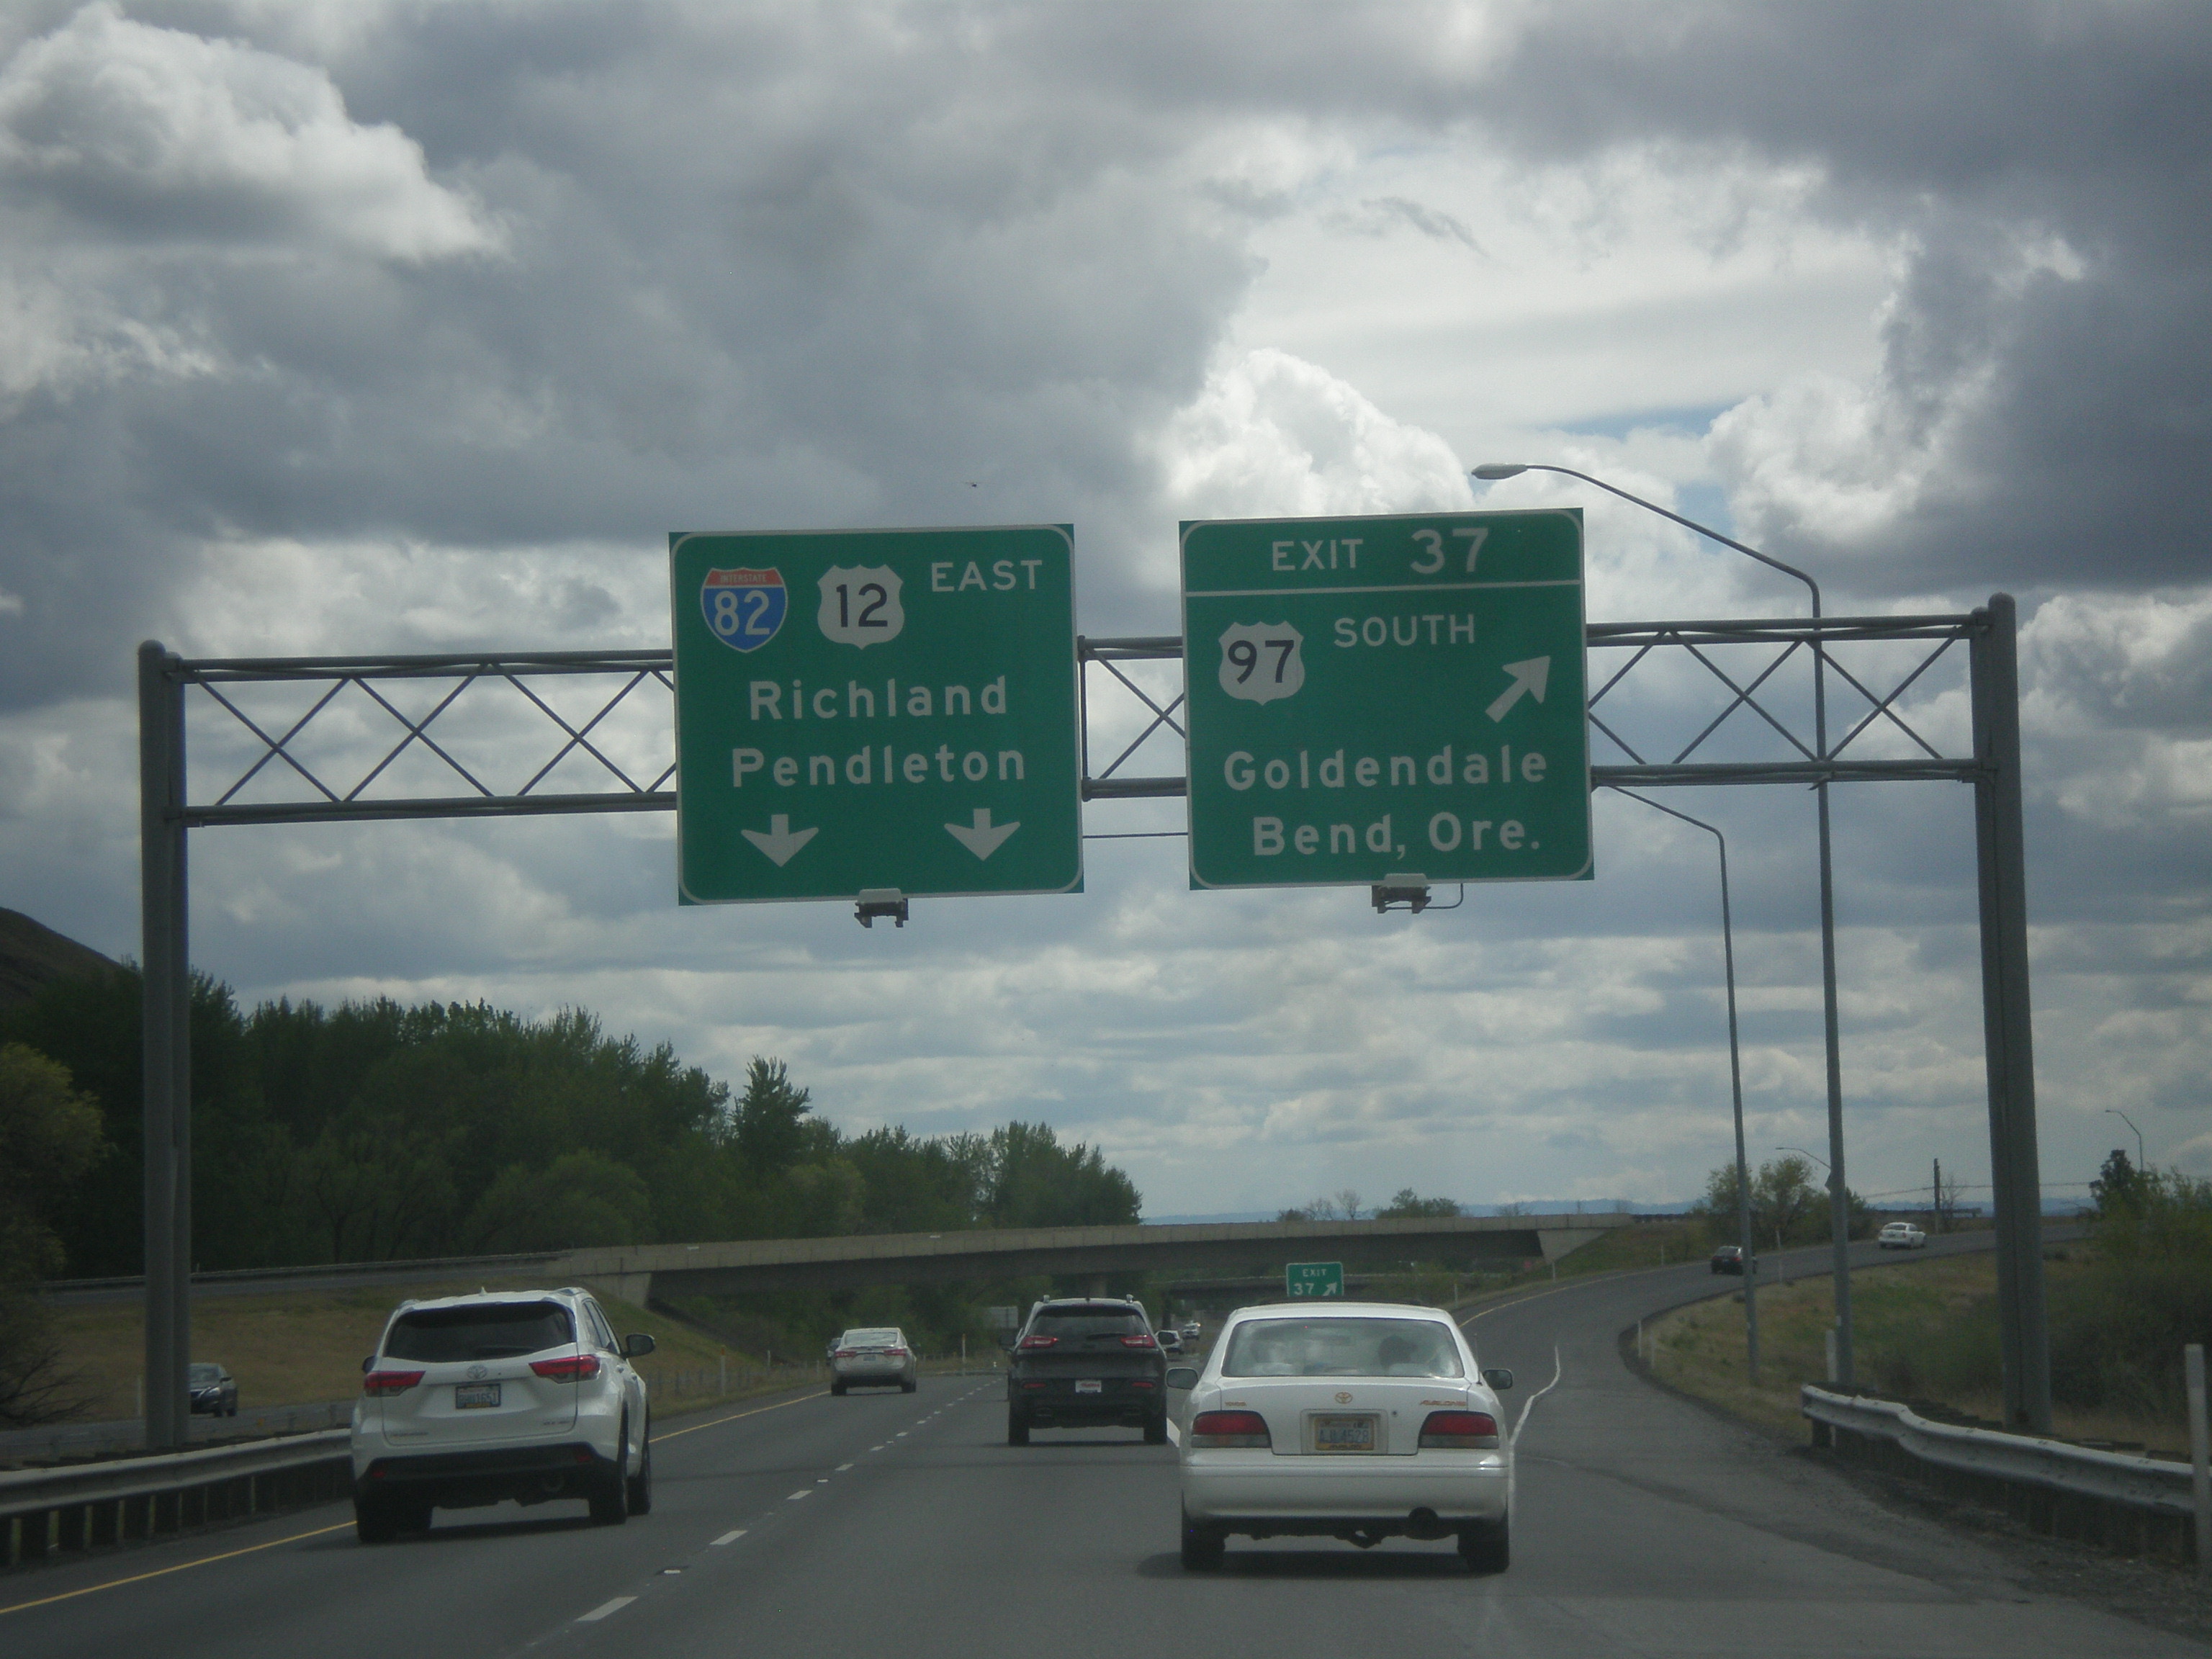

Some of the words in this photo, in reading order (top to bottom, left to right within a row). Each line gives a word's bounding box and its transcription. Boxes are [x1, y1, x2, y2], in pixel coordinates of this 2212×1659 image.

[1272, 539, 1363, 571] EXIT
[1411, 528, 1488, 574] 37
[721, 573, 768, 583] INTERSTATE
[931, 560, 1042, 592] EAST
[714, 590, 770, 636] 82
[836, 583, 888, 627] 12
[1334, 614, 1475, 648] SOUTH
[1228, 639, 1294, 683] 97
[750, 675, 1007, 720] Richland
[732, 745, 1025, 787] Pendleton
[1224, 745, 1547, 791] Goldendale
[1253, 814, 1406, 860] Bend,
[1429, 811, 1540, 851] Ore.
[1294, 1282, 1314, 1295] 37
